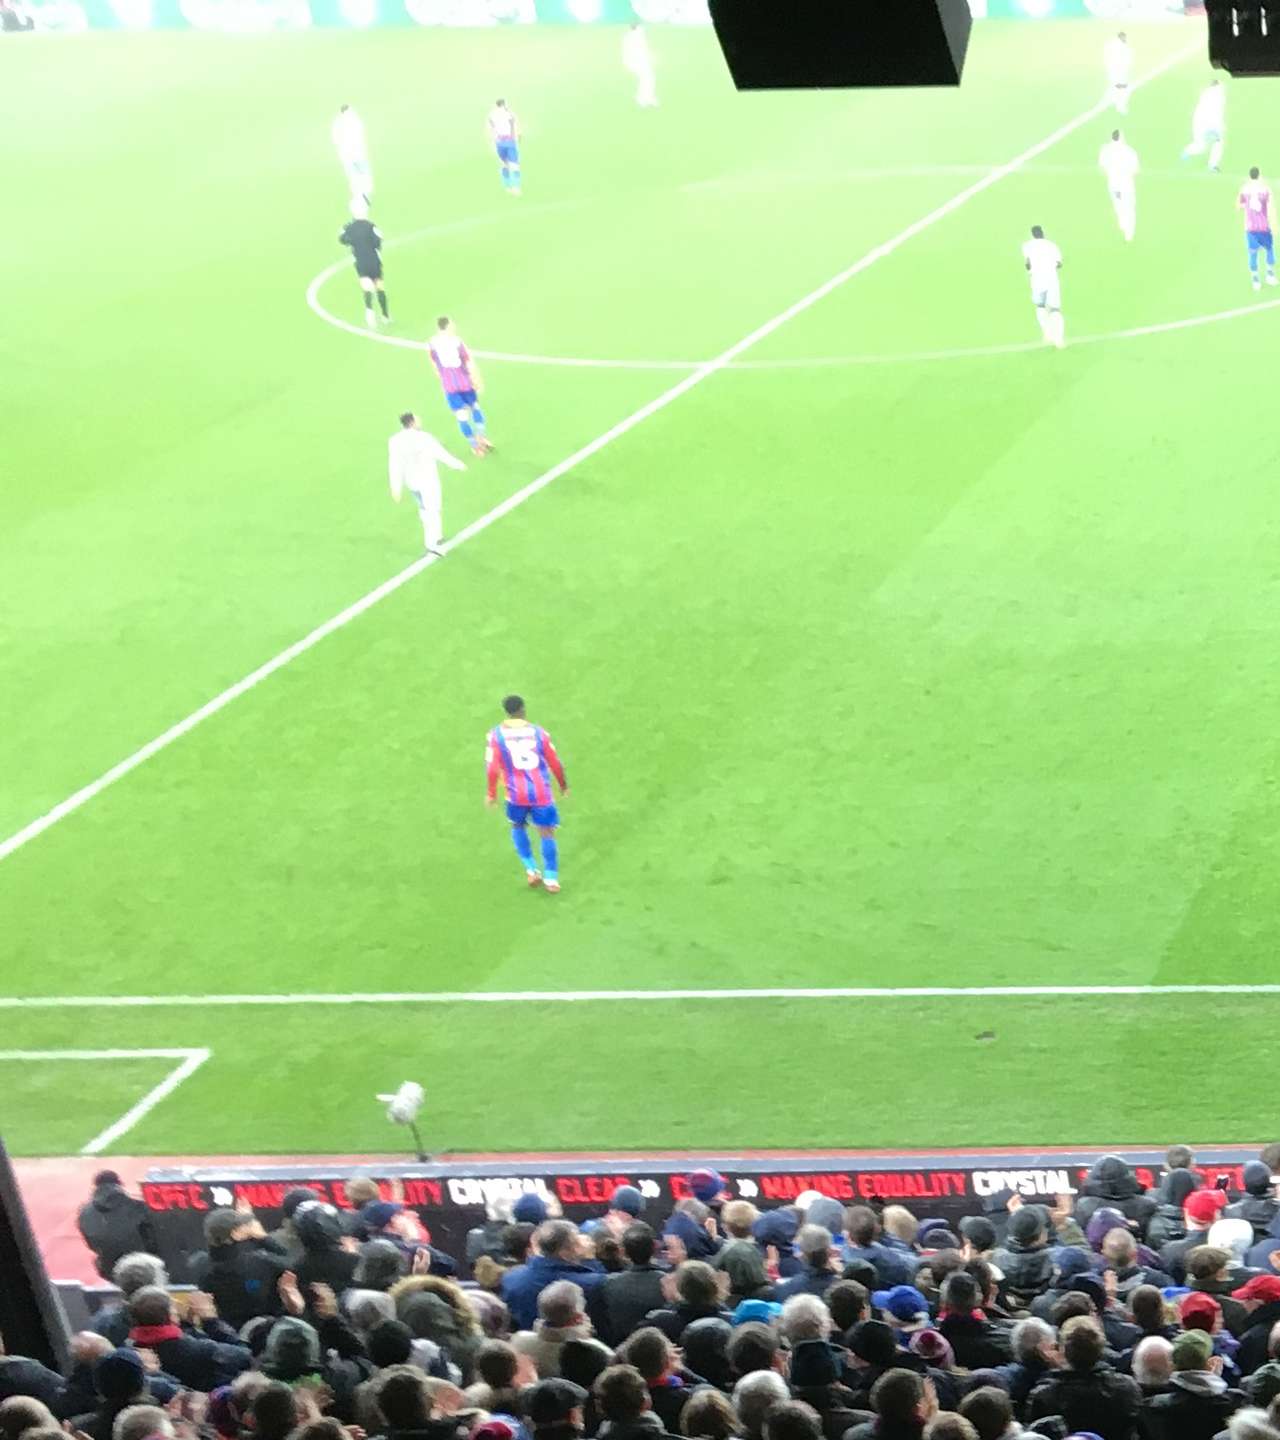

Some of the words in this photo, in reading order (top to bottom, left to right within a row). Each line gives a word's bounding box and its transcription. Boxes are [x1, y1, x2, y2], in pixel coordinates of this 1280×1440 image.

[760, 1174, 856, 1200] MAKING
[857, 1172, 967, 1198] EQUALITY
[972, 1170, 1078, 1197] CRYSTAL
